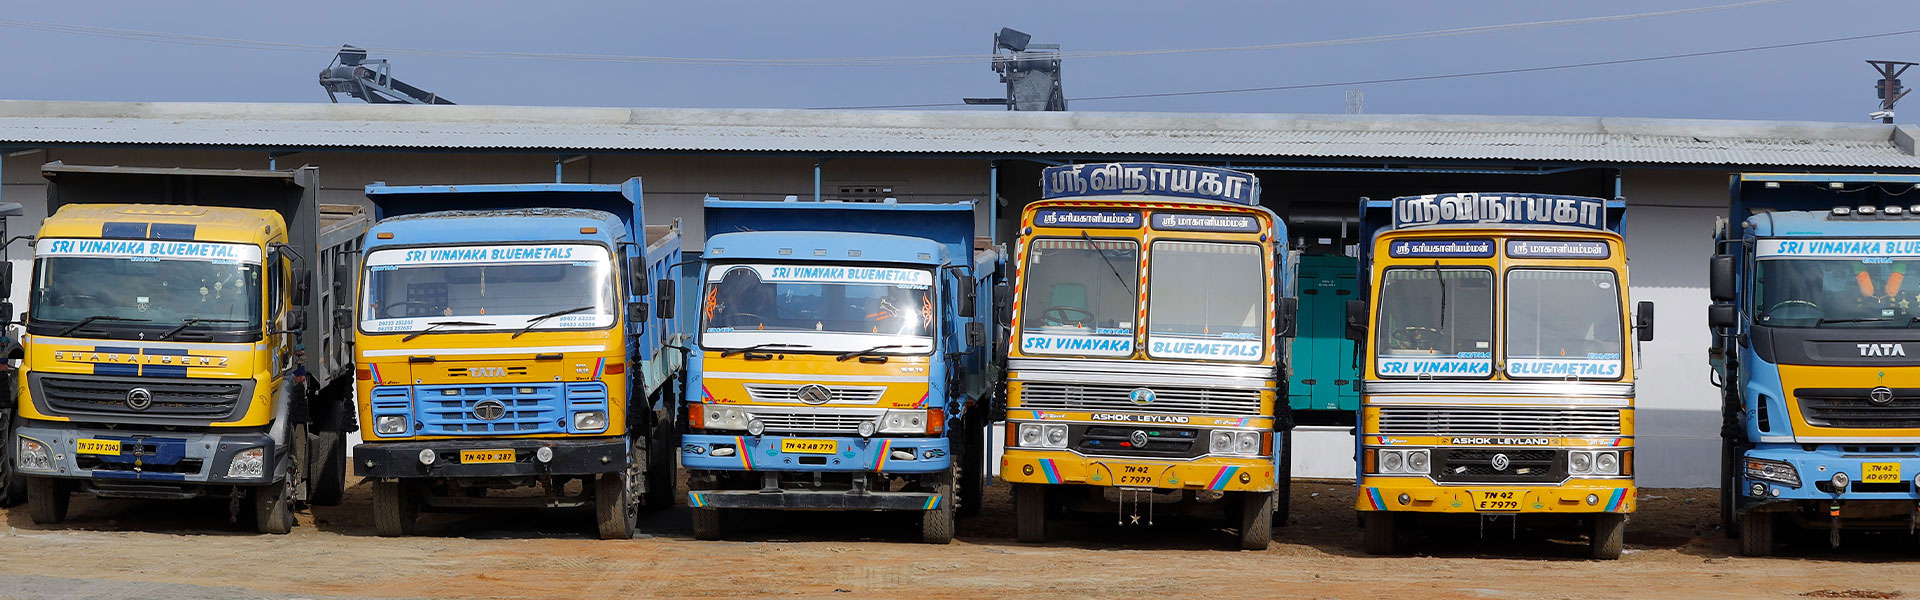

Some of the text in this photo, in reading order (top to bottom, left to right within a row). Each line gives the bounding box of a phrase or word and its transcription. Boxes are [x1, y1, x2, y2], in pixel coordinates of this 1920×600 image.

[50, 240, 241, 258] SRI VINAYAKA BLUEMETAL
[1777, 241, 1804, 254] SRI
[1809, 241, 1881, 254] VINAYAKA
[405, 247, 573, 262] SRI VINAYAKA BLUEMETALS
[772, 267, 920, 283] SRI VINAYAKA BLUEMETALS
[1024, 337, 1130, 351] SRI VINAYAKA
[1153, 341, 1260, 357] BLUEMETALS
[1857, 343, 1906, 357] TATA
[54, 350, 229, 367] BHARATBENZ
[467, 367, 506, 378] TATA
[1382, 361, 1489, 374] SRI VINAYAKA
[1510, 361, 1617, 375] BLUEMETALS
[1092, 413, 1189, 423] ASHOK LEYLAND
[78, 442, 86, 450] TN
[1452, 437, 1549, 446] ASHOK LEYLAND
[1137, 466, 1149, 474] 42
[1130, 476, 1152, 484] 7979
[1484, 491, 1514, 499] TN 42
[1490, 501, 1518, 509] 7979
